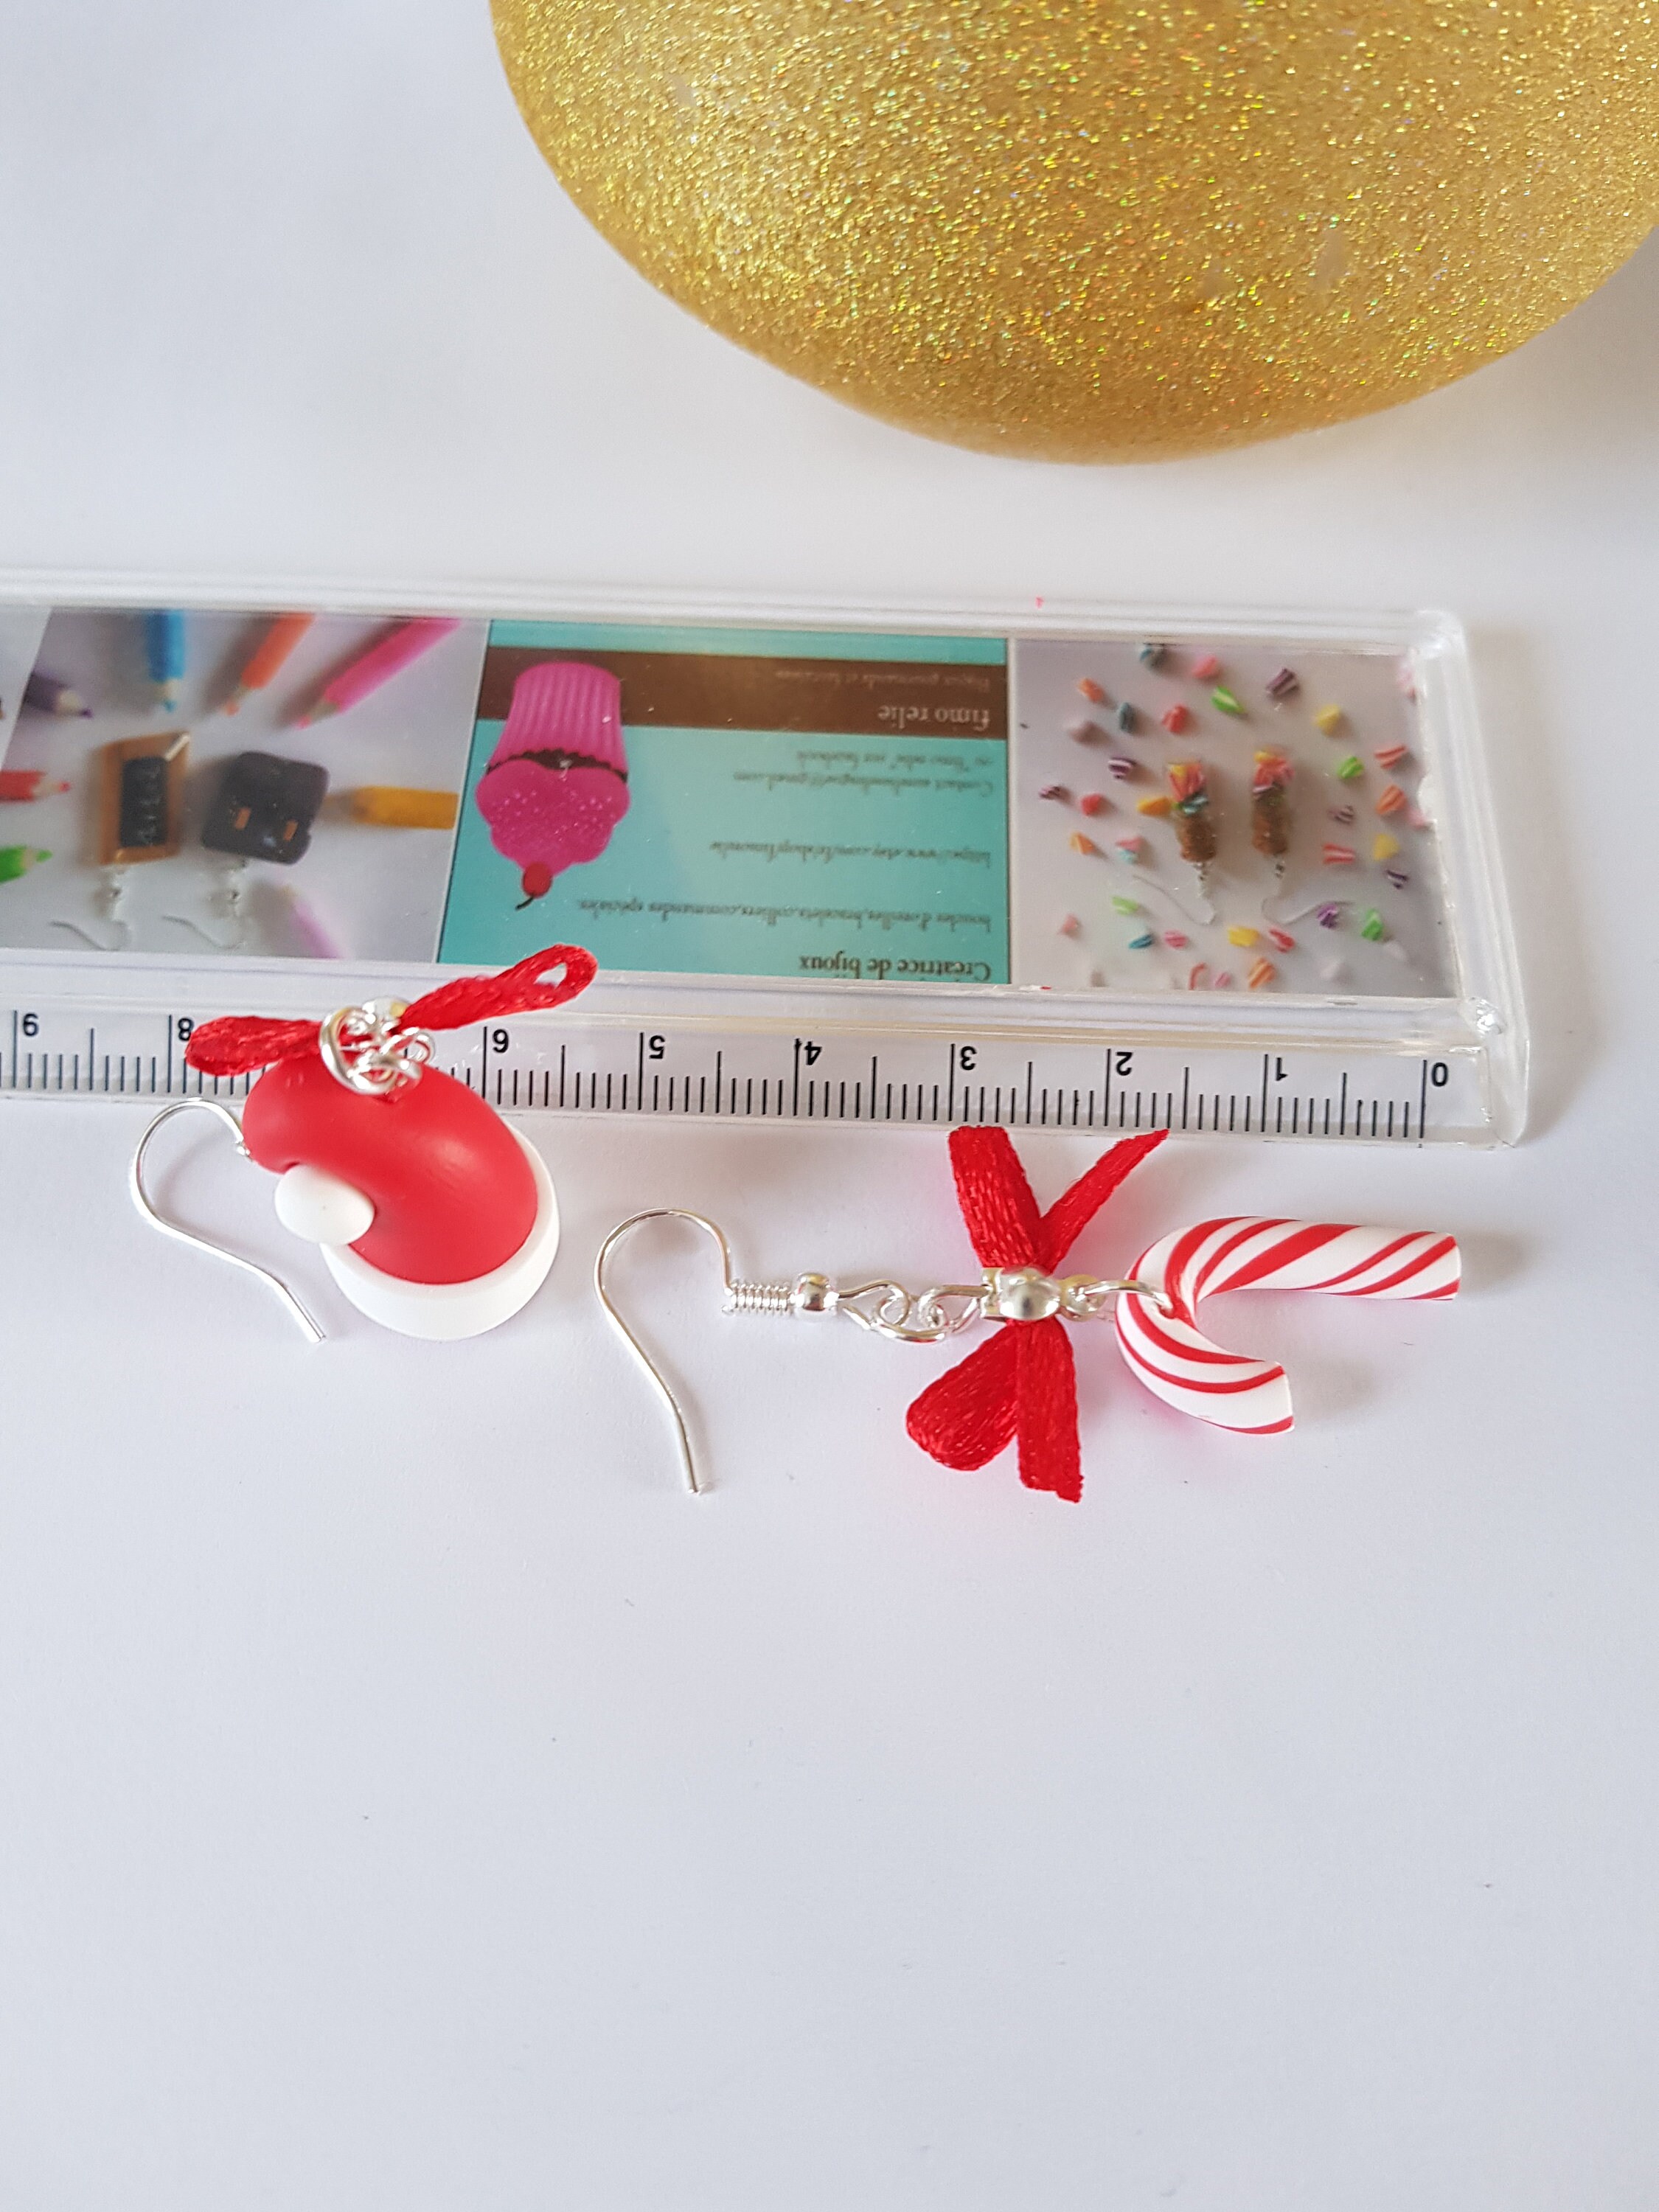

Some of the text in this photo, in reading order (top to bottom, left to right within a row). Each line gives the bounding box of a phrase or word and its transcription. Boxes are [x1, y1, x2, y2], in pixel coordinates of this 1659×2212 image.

[877, 705, 991, 732] fimo relie
[799, 949, 992, 982] Créatrice de bijoux
[22, 1013, 1448, 1088] 0 1 2 3 4 5 6 8 9
